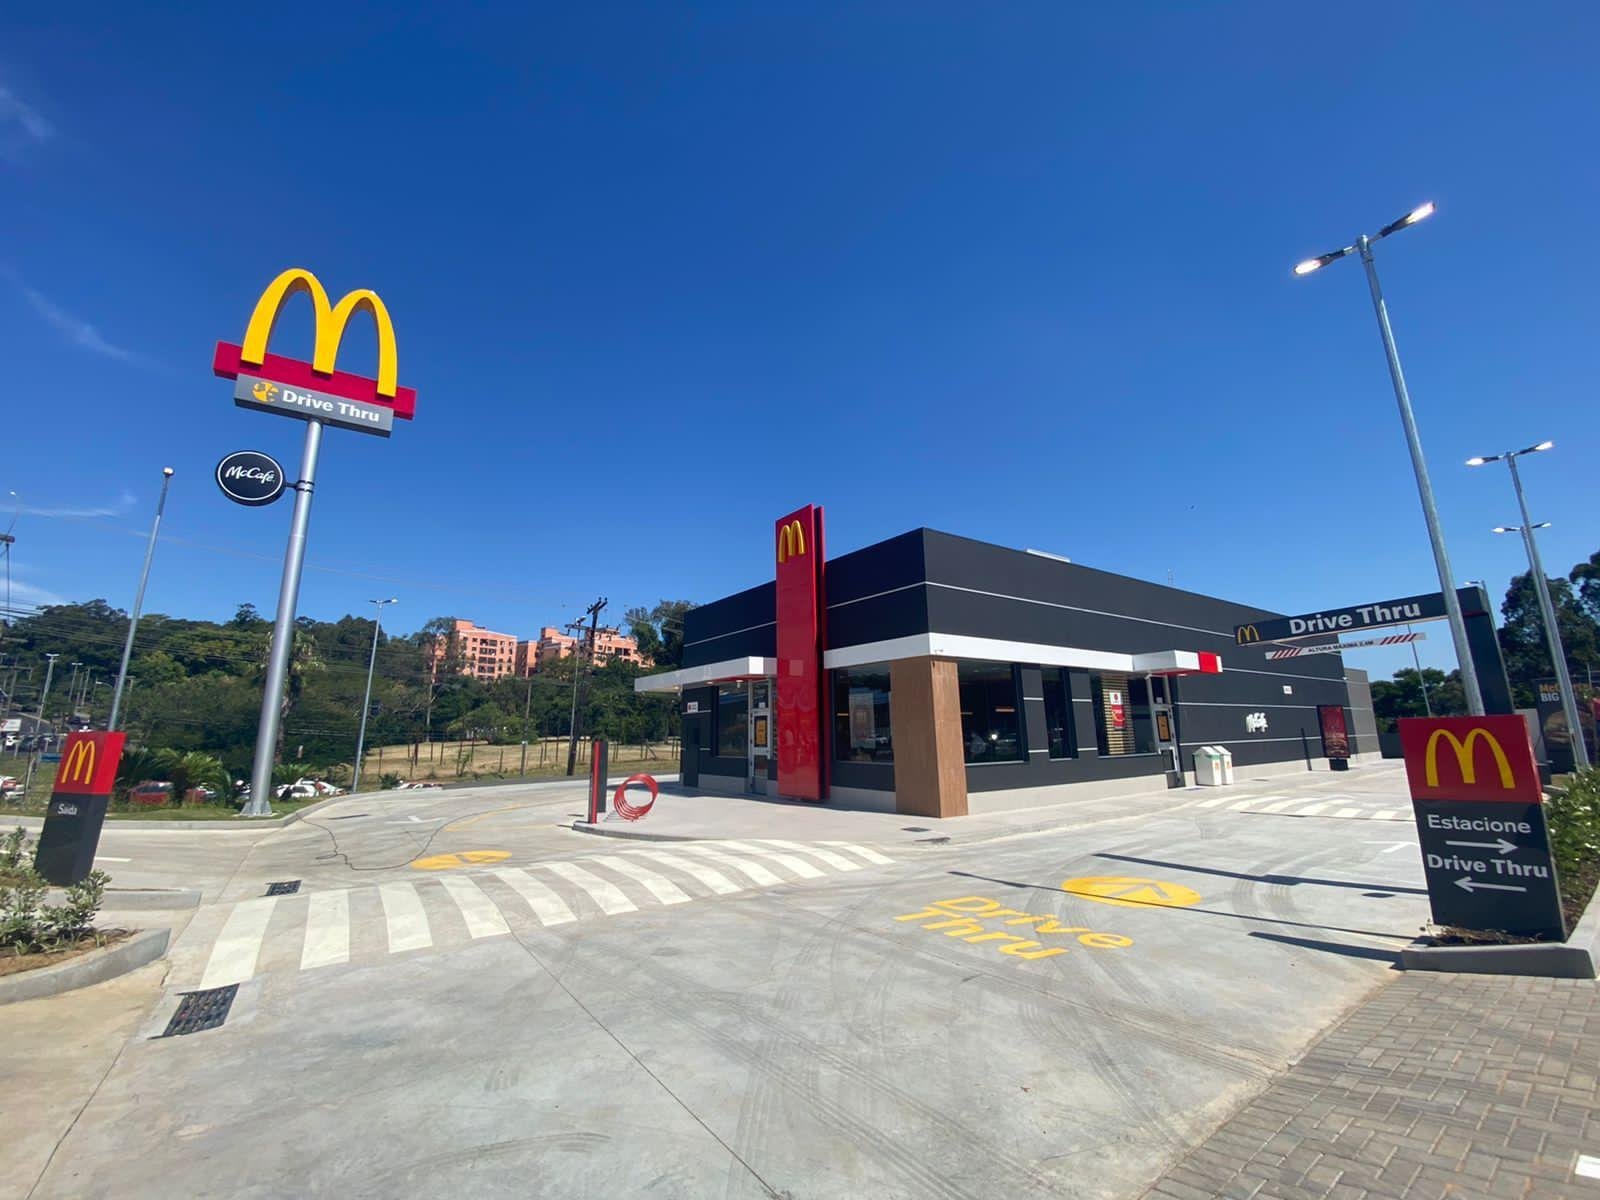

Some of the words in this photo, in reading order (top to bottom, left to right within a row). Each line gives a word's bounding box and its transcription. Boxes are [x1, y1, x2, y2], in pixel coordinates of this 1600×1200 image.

[283, 390, 334, 412] Drive
[338, 402, 380, 422] Thru
[225, 465, 275, 484] McCafé
[1289, 614, 1353, 635] Drive
[1357, 602, 1422, 625] Thru
[1540, 692, 1560, 702] BIG
[1427, 814, 1531, 833] Estacione
[1427, 854, 1487, 873] Drive
[1490, 858, 1548, 878] Thru
[893, 907, 1069, 960] Thru
[932, 896, 1134, 948] Drive
